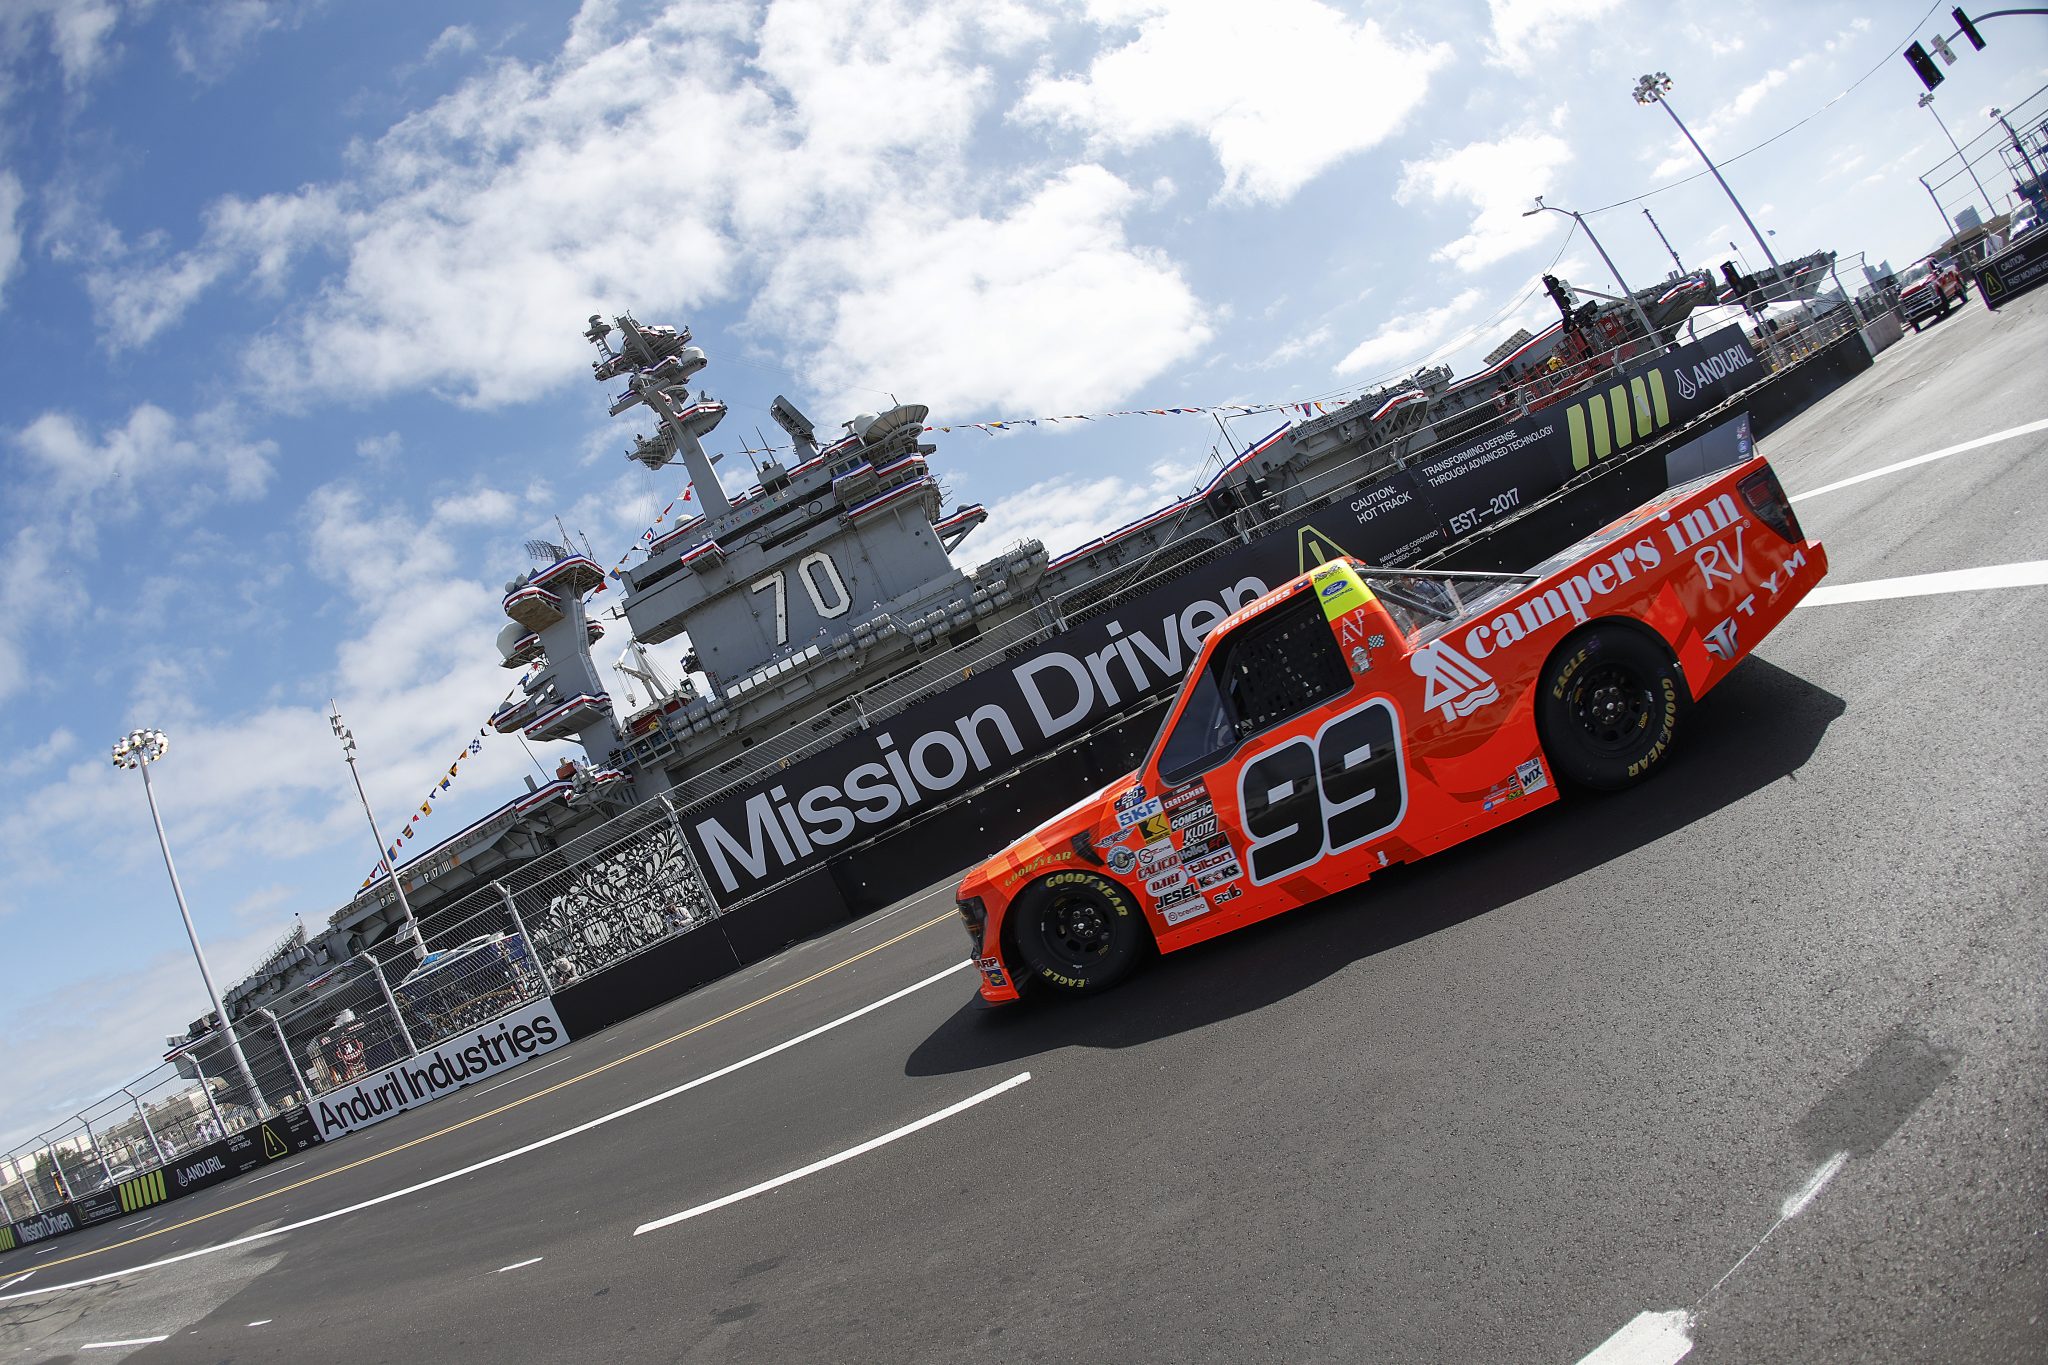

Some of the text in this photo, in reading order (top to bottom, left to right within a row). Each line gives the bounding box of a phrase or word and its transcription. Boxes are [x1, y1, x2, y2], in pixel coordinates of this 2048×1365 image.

[1693, 344, 1754, 388] ANDURIL
[1422, 430, 1518, 477] TRANSFORMING DEFENSE
[1428, 425, 1554, 488] THROUGH ADVANCED TECHNOLOGY
[1350, 485, 1397, 512] CAUTION:
[1357, 491, 1413, 524] HOT TRACK
[1379, 530, 1439, 563] NAVAL BASE CORONADO
[1695, 526, 1744, 590] RV
[1465, 494, 1744, 658] campers inn
[750, 551, 853, 645] 70
[1553, 649, 1587, 699] EAGLE
[696, 576, 1269, 894] Mission Driven
[1521, 766, 1542, 787] WIX
[1164, 785, 1206, 809] CRAFTSMAN
[1238, 697, 1408, 887] 99
[1118, 799, 1159, 827] SKF
[1171, 804, 1213, 829] COMETIC
[1185, 819, 1215, 841] KLOTZ
[1180, 843, 1209, 861] Holley
[1188, 851, 1232, 873] tilton
[1004, 851, 1072, 887] GOODYEAR
[1138, 855, 1177, 879] CALICO
[1198, 863, 1239, 888] KOOKS
[1045, 872, 1129, 917] GOODYEAR
[1155, 883, 1201, 909] JESEL
[1177, 903, 1206, 918] brembo
[1042, 967, 1086, 988] EAGLE
[319, 1015, 558, 1135] Anduril Industries
[297, 1139, 308, 1148] USA
[187, 1156, 226, 1182] ANDURIL
[16, 1212, 74, 1243] Mission Driven
